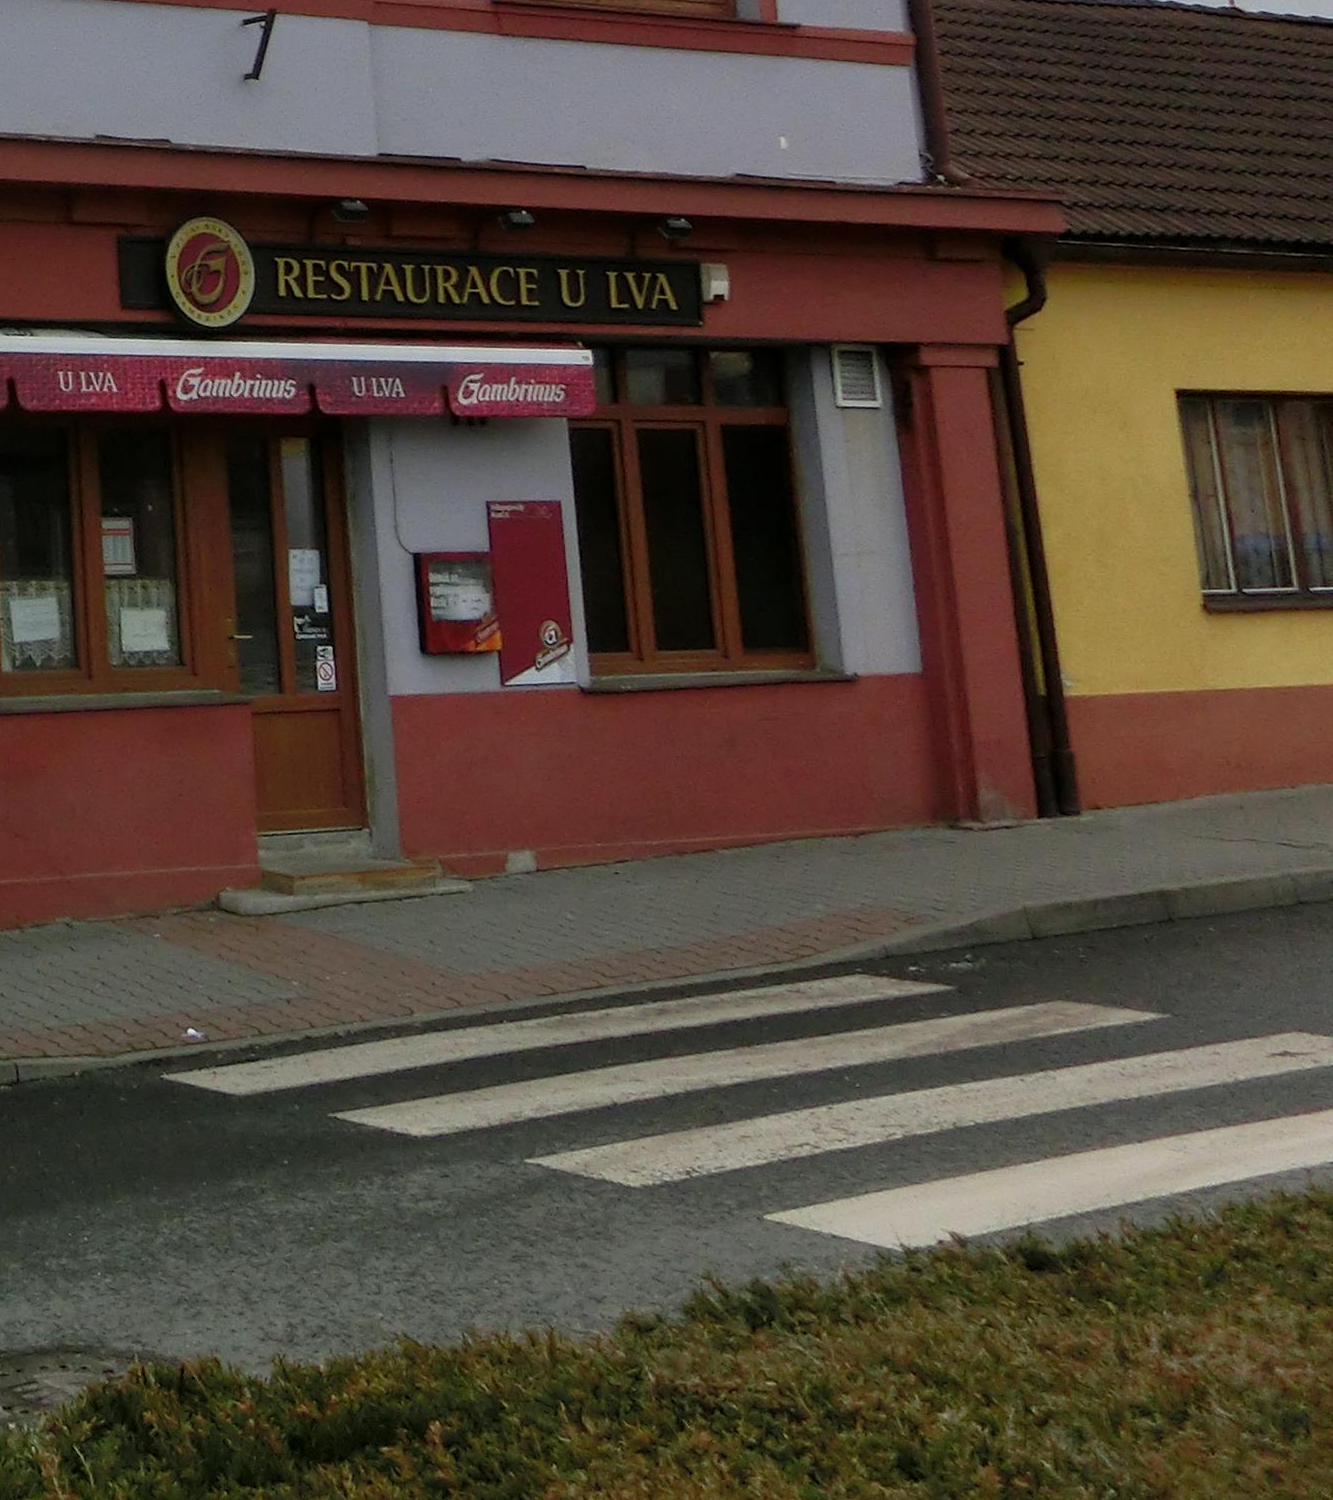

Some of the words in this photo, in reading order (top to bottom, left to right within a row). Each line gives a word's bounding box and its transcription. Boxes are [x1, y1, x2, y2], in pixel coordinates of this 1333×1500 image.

[274, 257, 540, 306] RESTAURACE
[557, 268, 586, 308] U
[605, 271, 679, 311] LVA
[57, 371, 74, 392] U
[79, 372, 119, 393] LVA
[176, 367, 298, 400] Gambrinus
[351, 376, 369, 398] U
[372, 377, 406, 399] LVA
[457, 372, 567, 406] Gambrinus
